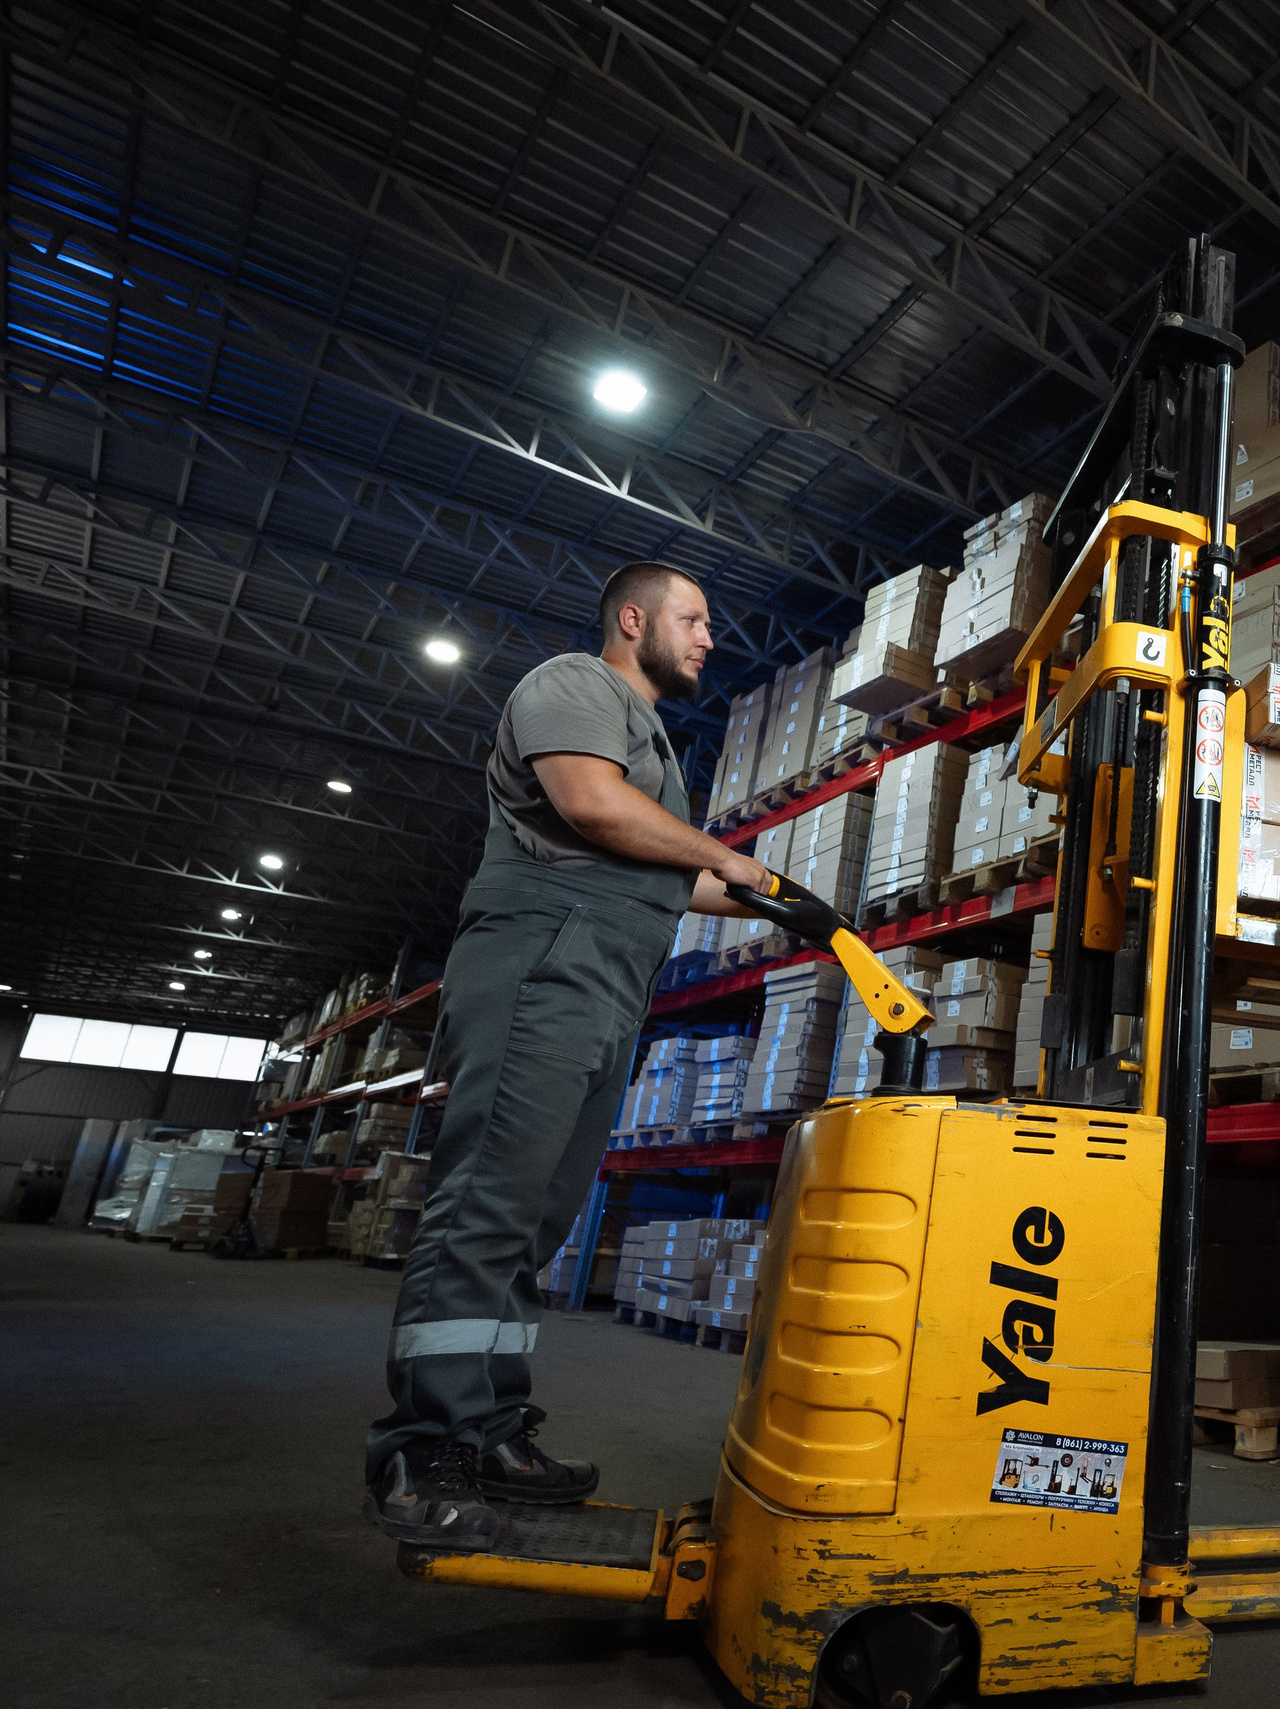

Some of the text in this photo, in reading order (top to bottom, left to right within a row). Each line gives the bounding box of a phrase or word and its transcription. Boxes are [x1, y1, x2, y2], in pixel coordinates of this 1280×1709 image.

[976, 1206, 1065, 1416] Yale
[1017, 1432, 1043, 1441] AVALON
[1056, 1437, 1062, 1446] 8
[1062, 1438, 1083, 1450] (861)
[1083, 1441, 1125, 1453] 2-999-363
